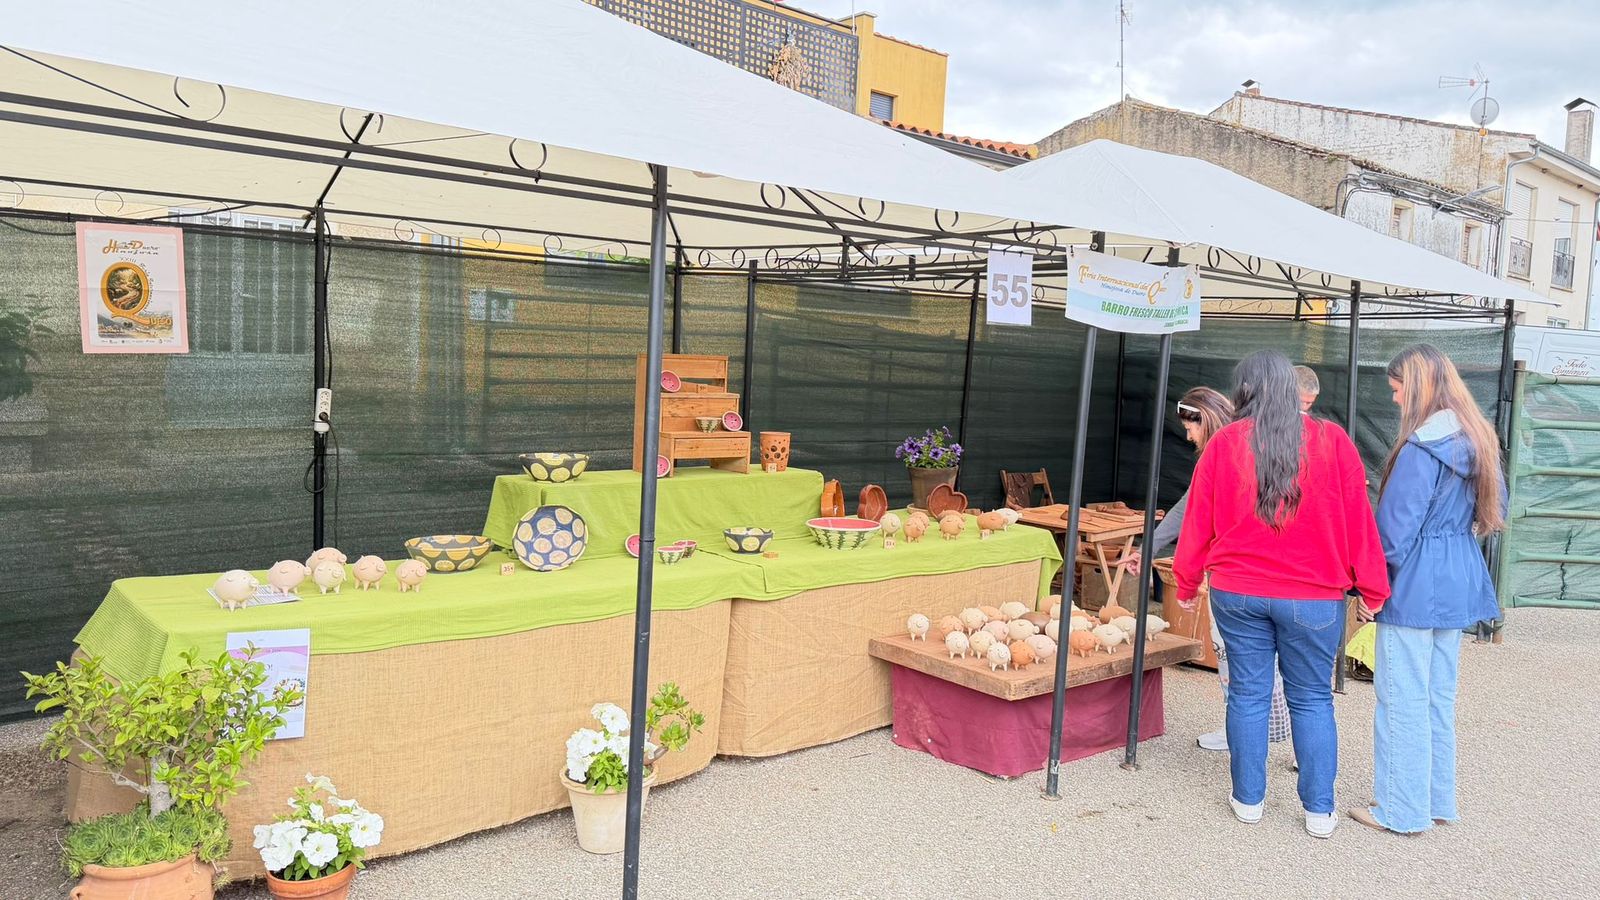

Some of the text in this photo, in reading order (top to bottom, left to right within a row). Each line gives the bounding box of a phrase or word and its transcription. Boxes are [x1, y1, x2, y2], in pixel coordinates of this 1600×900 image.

[991, 273, 1028, 308] 55
[1098, 273, 1141, 289] Internacional
[1101, 300, 1129, 317] BARRO
[1129, 306, 1152, 319] FRESCO
[1152, 308, 1170, 319] TALLER
